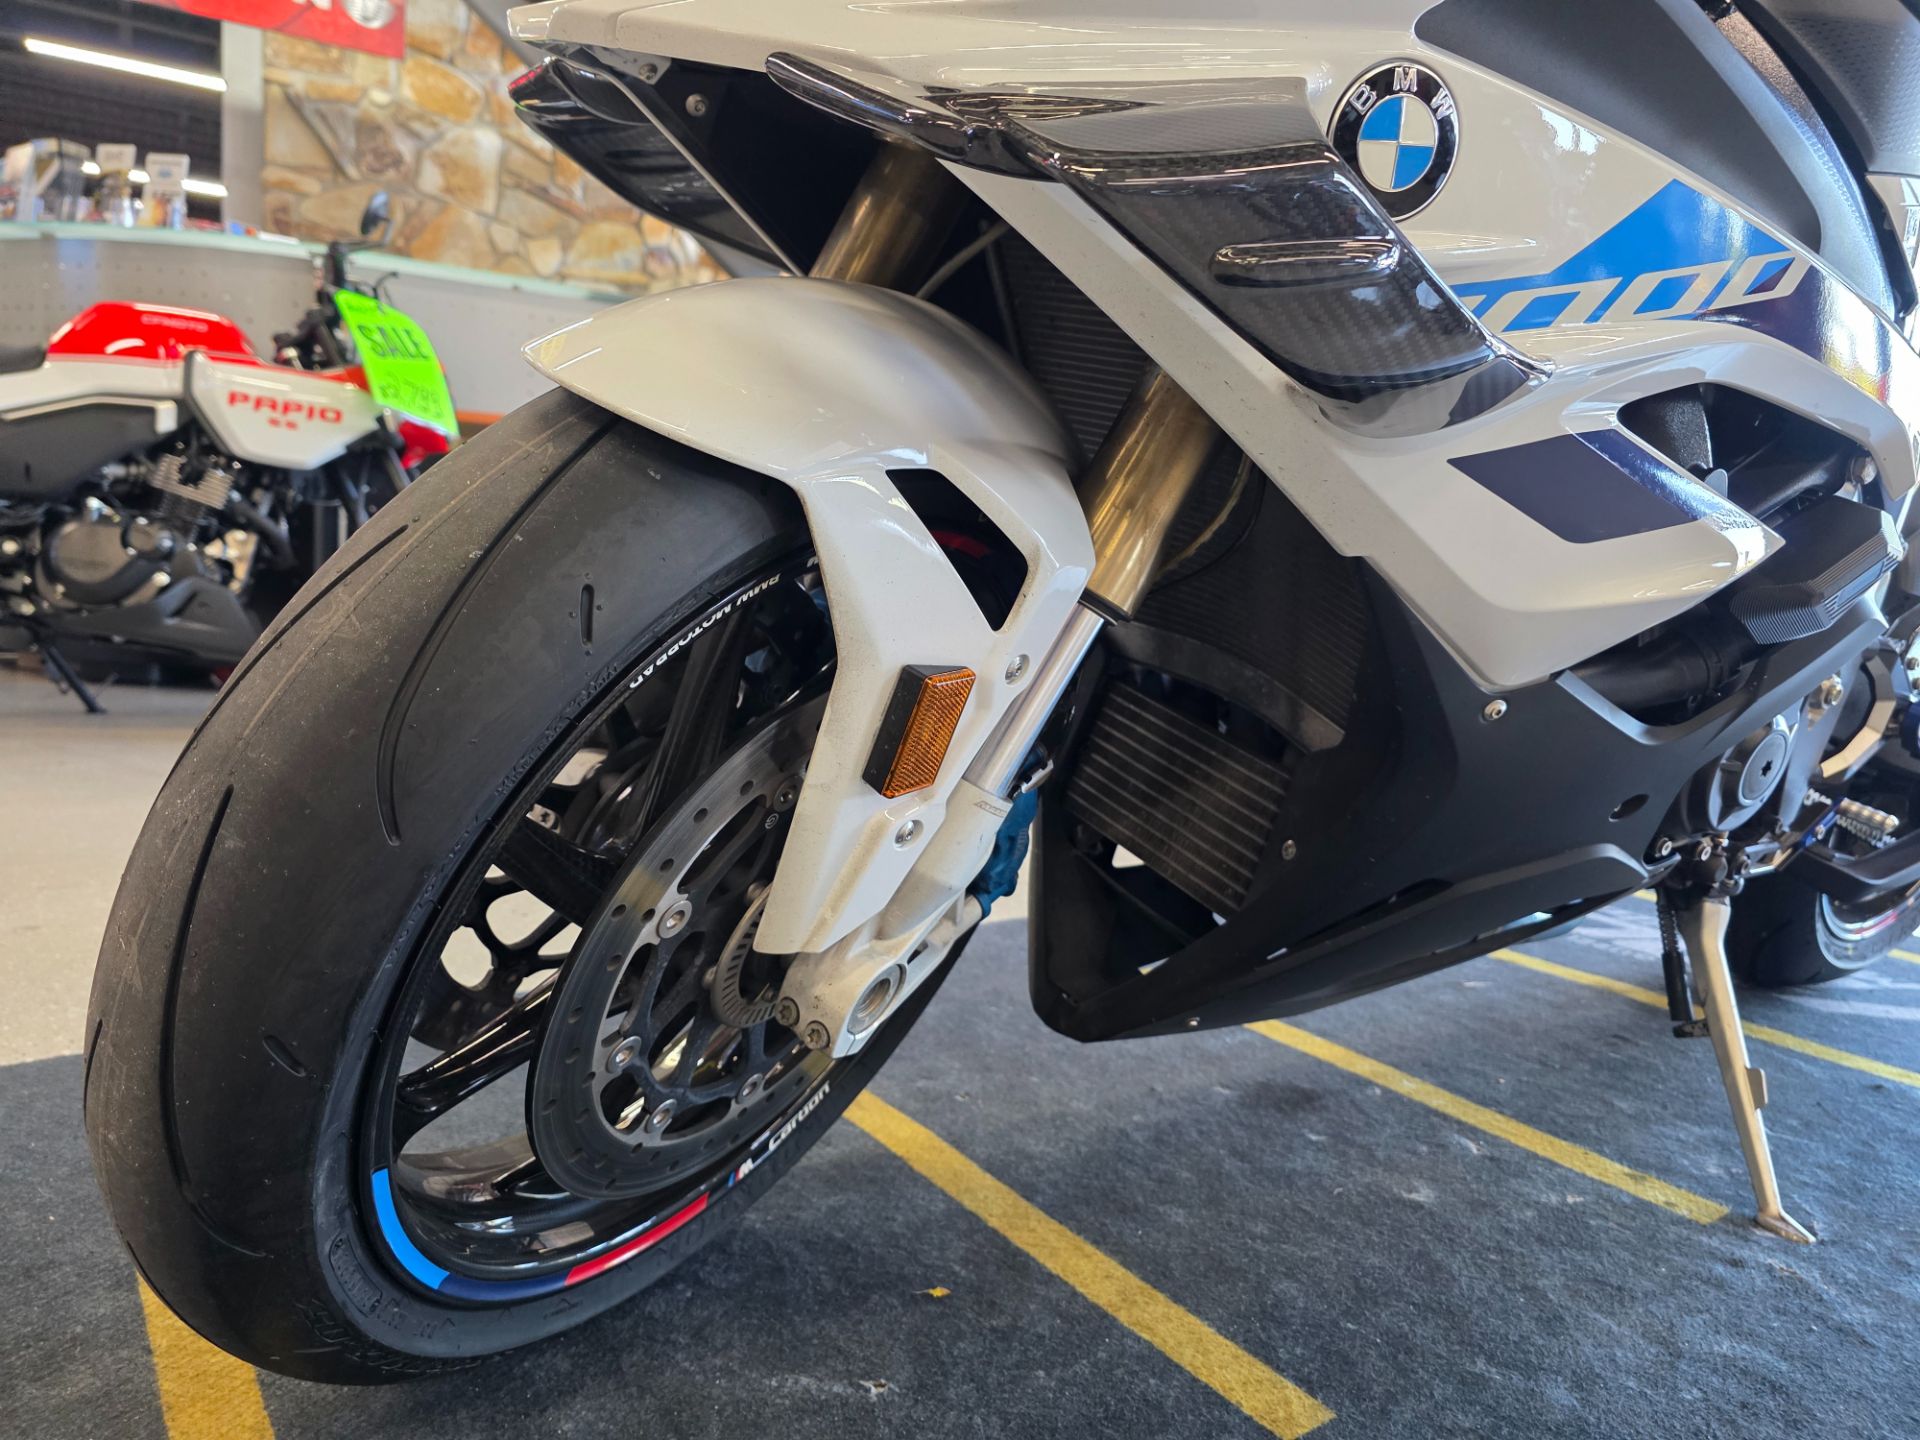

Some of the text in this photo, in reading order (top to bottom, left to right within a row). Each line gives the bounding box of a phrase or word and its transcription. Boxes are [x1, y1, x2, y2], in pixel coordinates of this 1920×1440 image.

[1350, 65, 1453, 120] BMW
[357, 324, 431, 360] SALE
[228, 391, 343, 424] PAPIO
[629, 603, 732, 689] MOTORRAD
